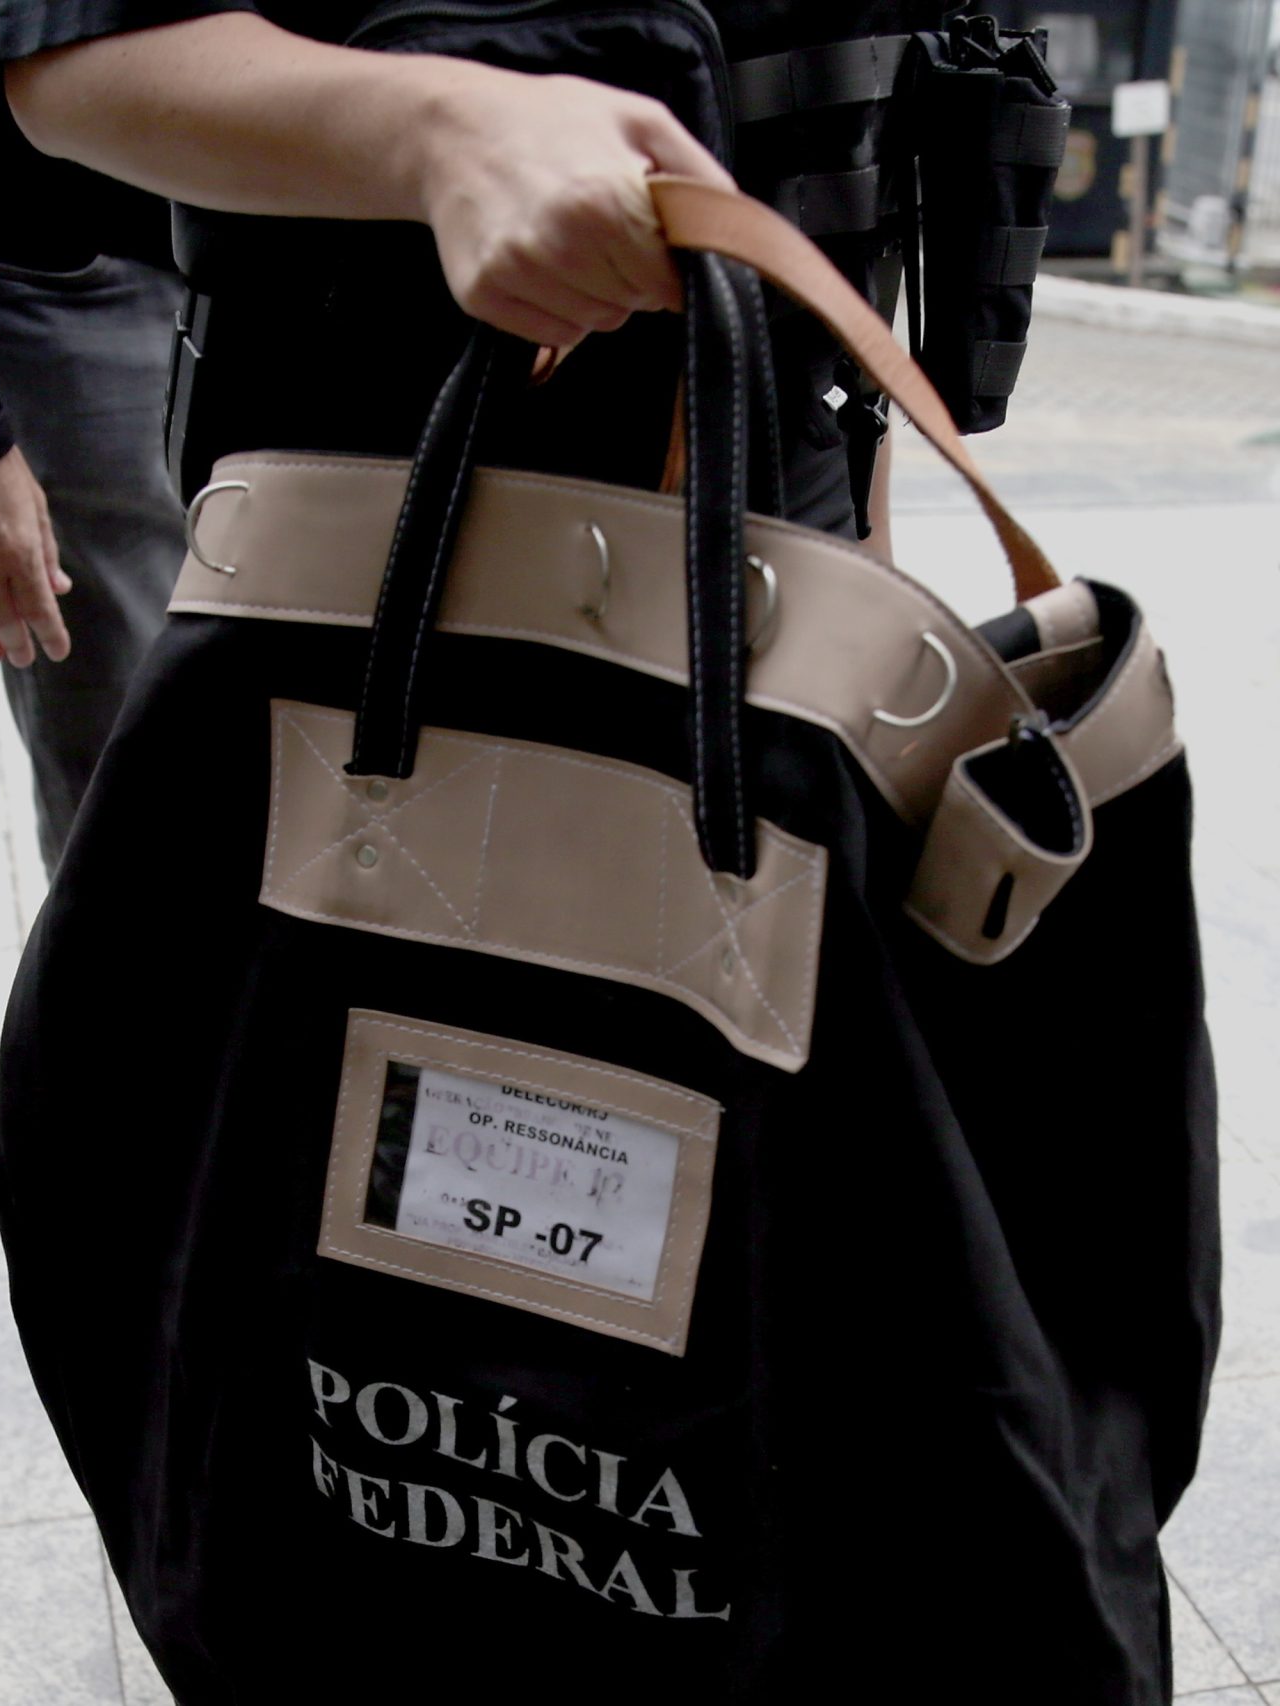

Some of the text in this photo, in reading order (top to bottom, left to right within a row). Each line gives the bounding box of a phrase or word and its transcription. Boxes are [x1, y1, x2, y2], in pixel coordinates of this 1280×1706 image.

[470, 1112, 498, 1129] OP.
[504, 1120, 629, 1165] RESSONÂNCIA
[464, 1198, 521, 1237] SP
[535, 1222, 604, 1262] -07
[307, 1358, 703, 1538] POLÍCIA
[309, 1434, 731, 1621] FEDERAL
